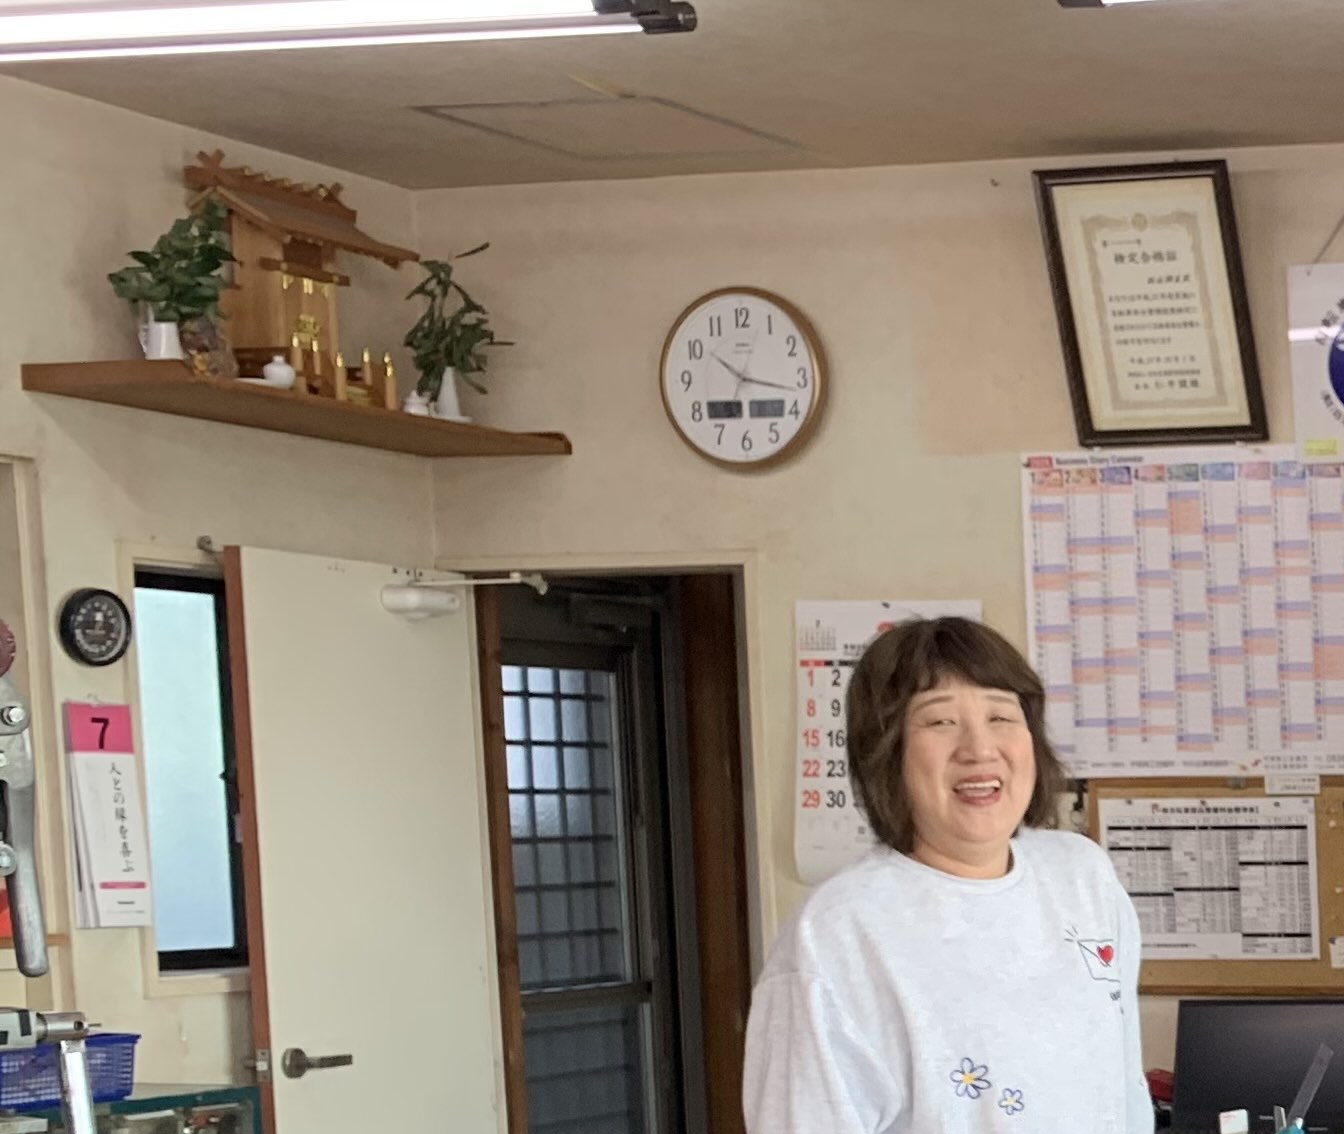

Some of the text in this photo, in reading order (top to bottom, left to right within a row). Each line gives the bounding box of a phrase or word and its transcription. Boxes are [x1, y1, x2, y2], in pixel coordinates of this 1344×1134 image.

[709, 315, 722, 337] 11
[734, 307, 750, 328] 12
[767, 314, 773, 335] 1
[688, 338, 703, 361] 10
[786, 335, 797, 357] 2
[680, 370, 692, 392] 9
[796, 367, 808, 389] 3
[691, 401, 703, 422] 8
[788, 399, 800, 420] 4
[713, 423, 726, 445] 7
[741, 429, 753, 451] 6
[767, 422, 780, 444] 5
[808, 669, 841, 687] 1 2
[806, 699, 841, 718] 8 9
[91, 717, 109, 749] 7
[802, 730, 846, 748] 15 16
[802, 760, 846, 778] 22 23
[802, 790, 846, 809] 29 30
